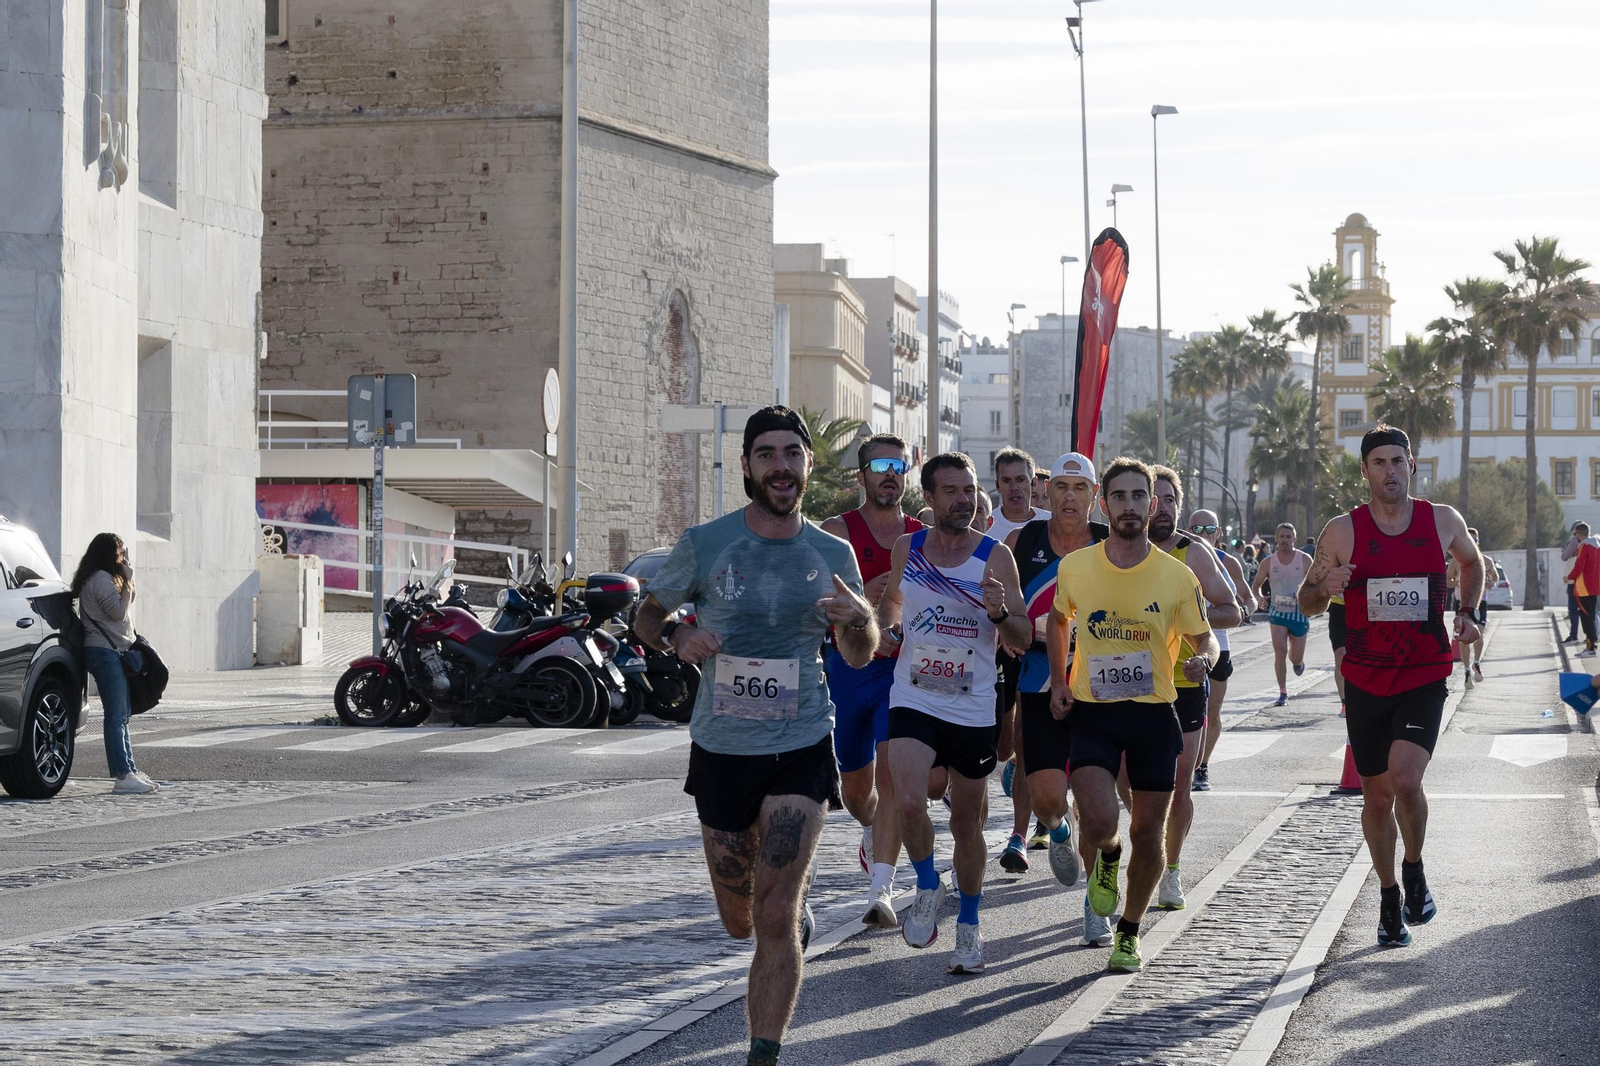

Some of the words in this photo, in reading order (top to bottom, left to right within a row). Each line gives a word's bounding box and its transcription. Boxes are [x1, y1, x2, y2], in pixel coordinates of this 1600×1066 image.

[1375, 590, 1420, 607] 1629
[1097, 627, 1132, 641] WORLD
[1132, 630, 1151, 641] RUN
[919, 658, 965, 679] 2581
[1097, 665, 1144, 684] 1386
[732, 675, 779, 699] 566
